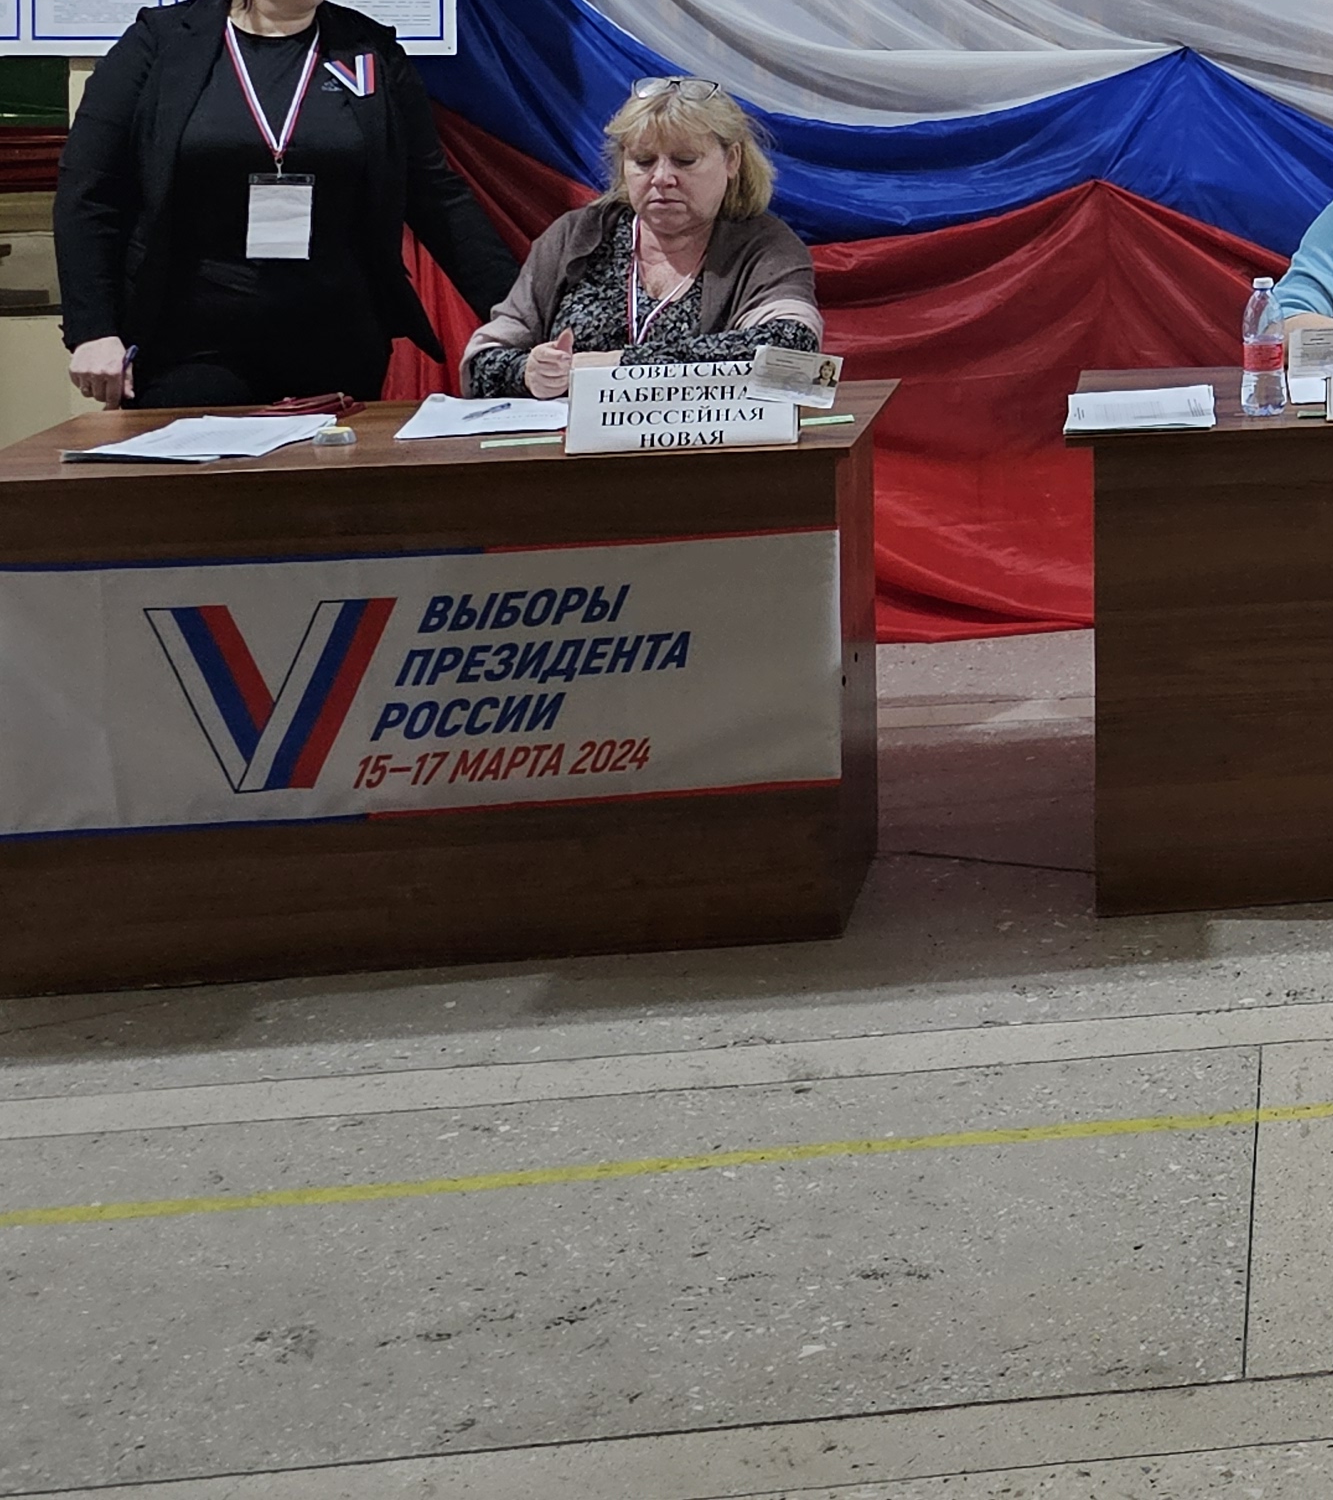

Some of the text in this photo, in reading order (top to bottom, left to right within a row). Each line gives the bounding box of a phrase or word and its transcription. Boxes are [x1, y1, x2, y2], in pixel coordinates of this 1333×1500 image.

[602, 405, 764, 427] ШОССЕЙНАЯ
[640, 430, 724, 448] НОВАЯ
[417, 584, 631, 633] ВЫБОРЫ
[394, 631, 692, 687] ПРЕЗИДЕНТА
[370, 692, 567, 742] РОССИИ
[448, 743, 566, 784] МАРТА
[568, 737, 652, 775] 2024
